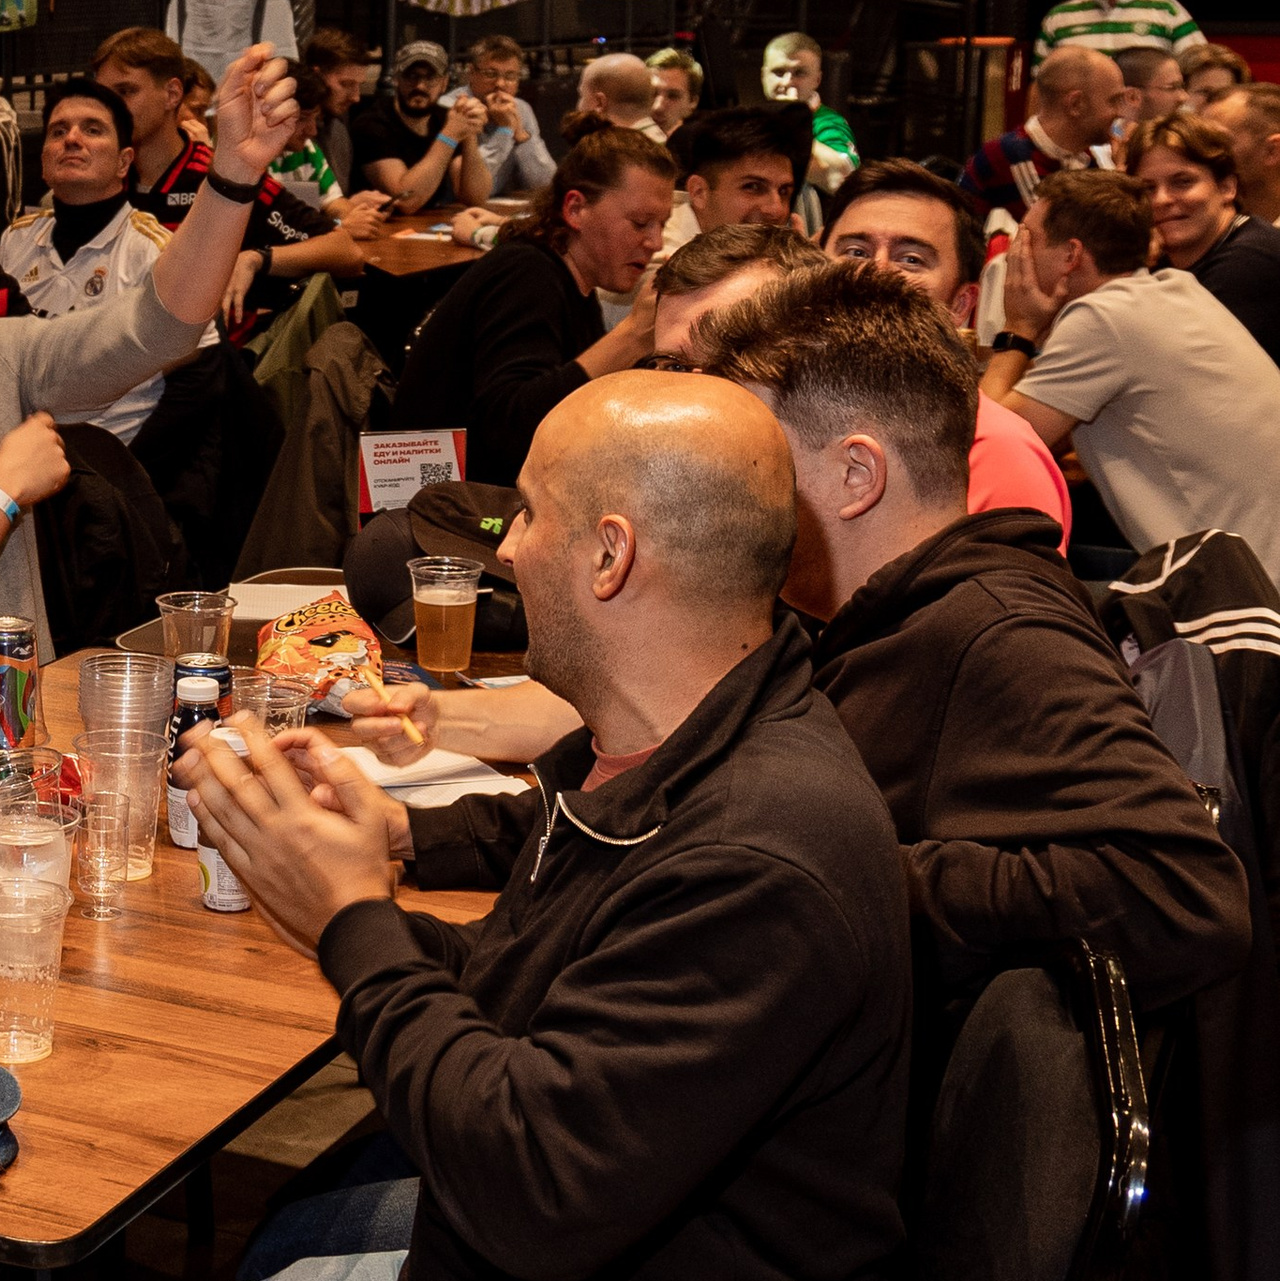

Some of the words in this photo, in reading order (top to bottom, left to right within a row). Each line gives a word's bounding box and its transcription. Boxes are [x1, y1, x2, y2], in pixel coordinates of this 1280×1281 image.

[267, 210, 309, 241] Shopee
[373, 439, 439, 450] ЗАКАЗЫВАЙТЕ
[399, 448, 442, 456] НАПИТКИ
[373, 456, 411, 465] ОНЛАЙН
